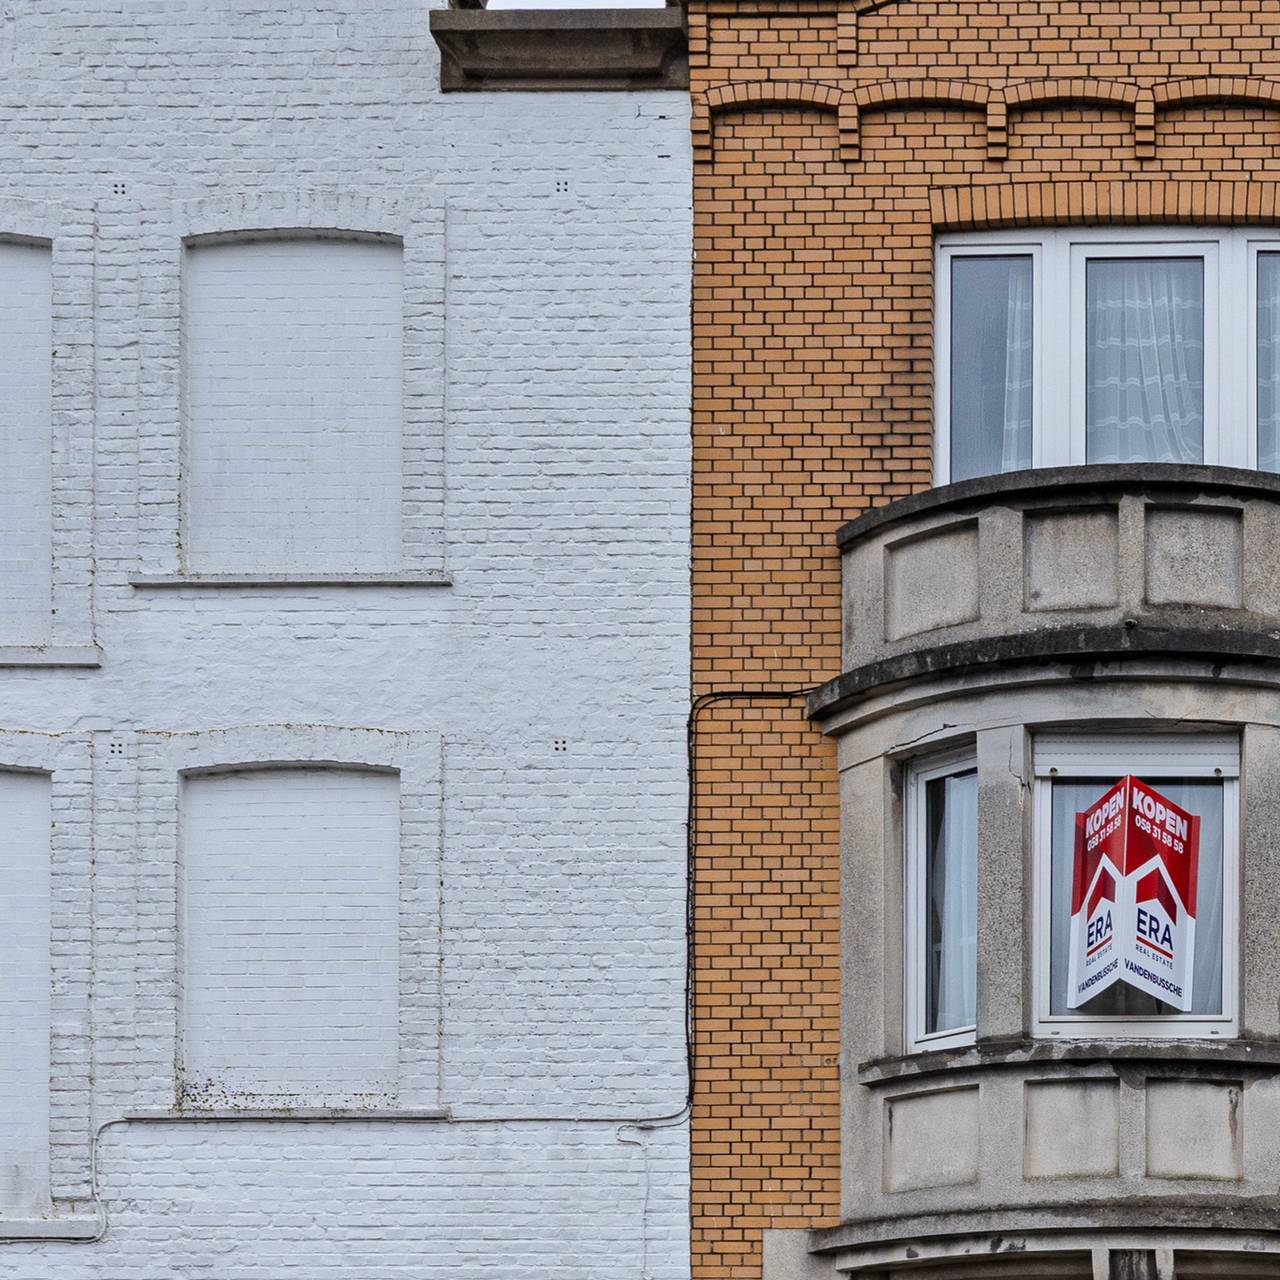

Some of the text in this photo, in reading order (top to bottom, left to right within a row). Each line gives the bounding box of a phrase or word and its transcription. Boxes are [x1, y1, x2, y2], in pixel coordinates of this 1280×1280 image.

[1086, 787, 1124, 838] KOPEN
[1132, 786, 1188, 842] KOPEN
[1135, 814, 1184, 854] 058 31 58 58
[1087, 909, 1113, 948] ERA
[1136, 907, 1173, 951] ERA
[1078, 958, 1118, 994] VANDENBUSSCHE
[1135, 943, 1173, 970] REAL ESTATE
[1124, 958, 1182, 998] VANDENBUSSCHE
